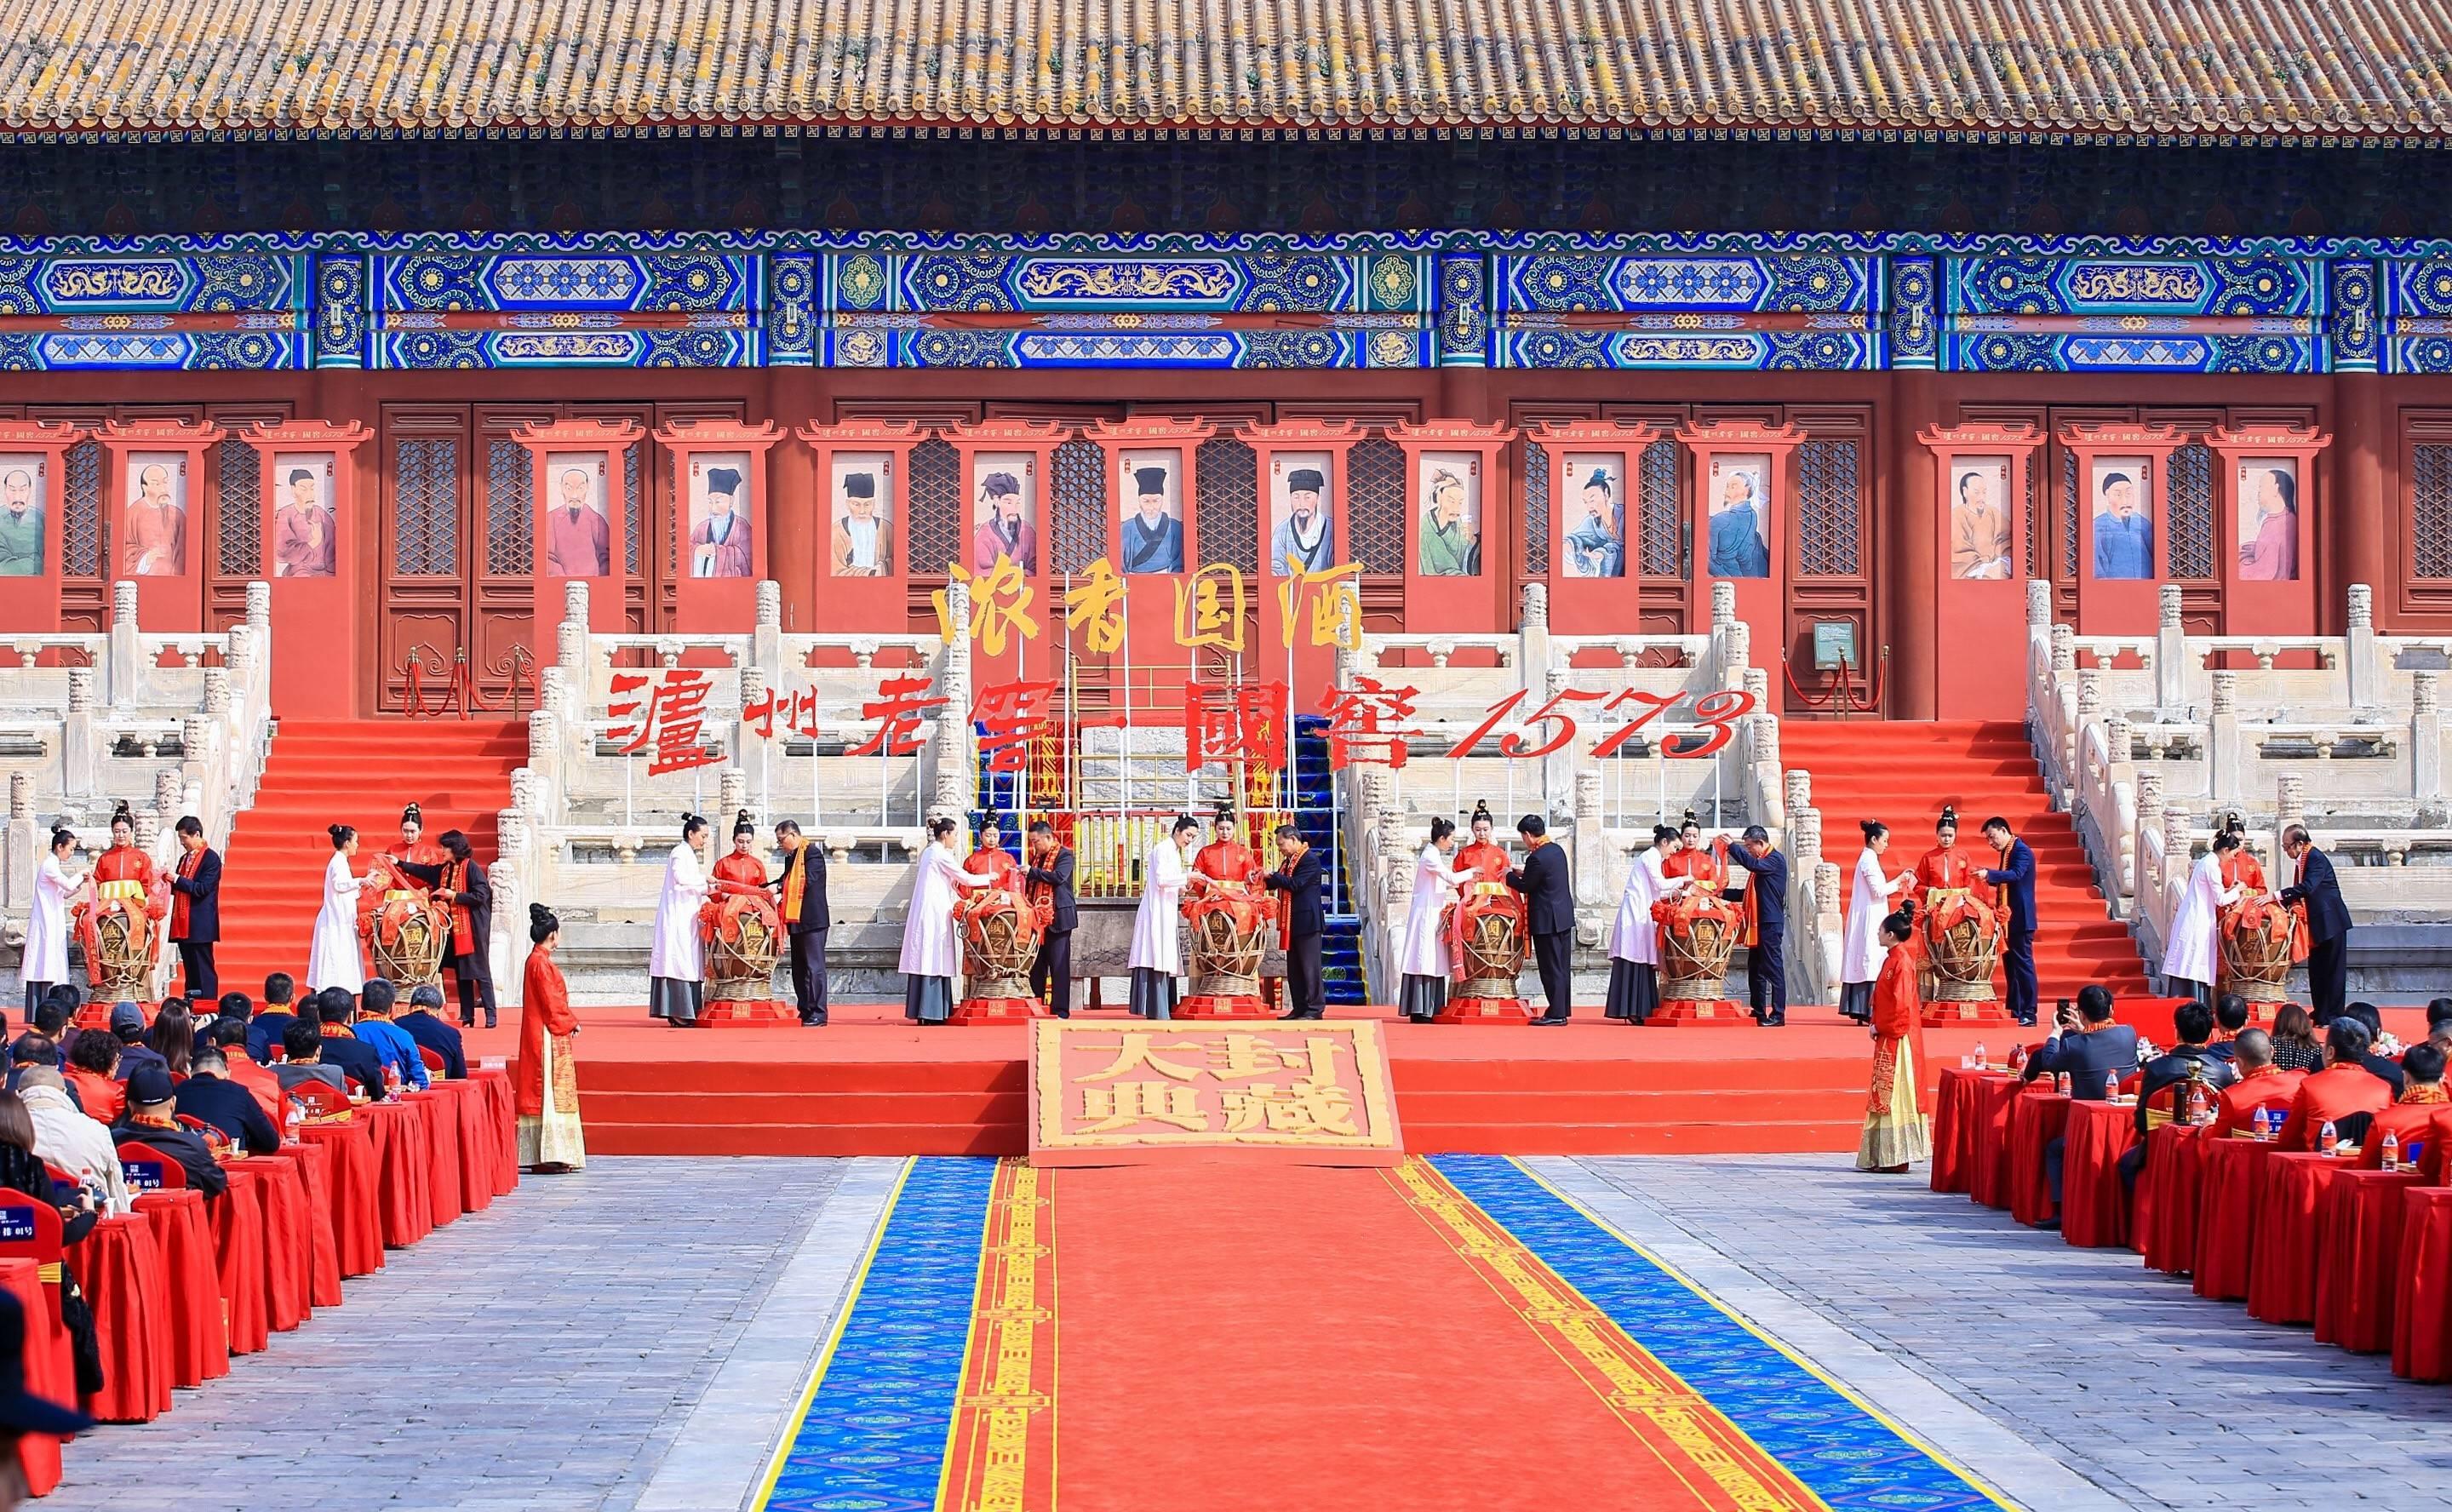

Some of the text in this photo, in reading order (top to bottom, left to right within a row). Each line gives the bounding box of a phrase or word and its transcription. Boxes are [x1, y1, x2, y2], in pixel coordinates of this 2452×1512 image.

[931, 553, 1364, 656] 浓香国酒
[1071, 1034, 1347, 1086] 大封
[1071, 1081, 1361, 1136] 典藏
